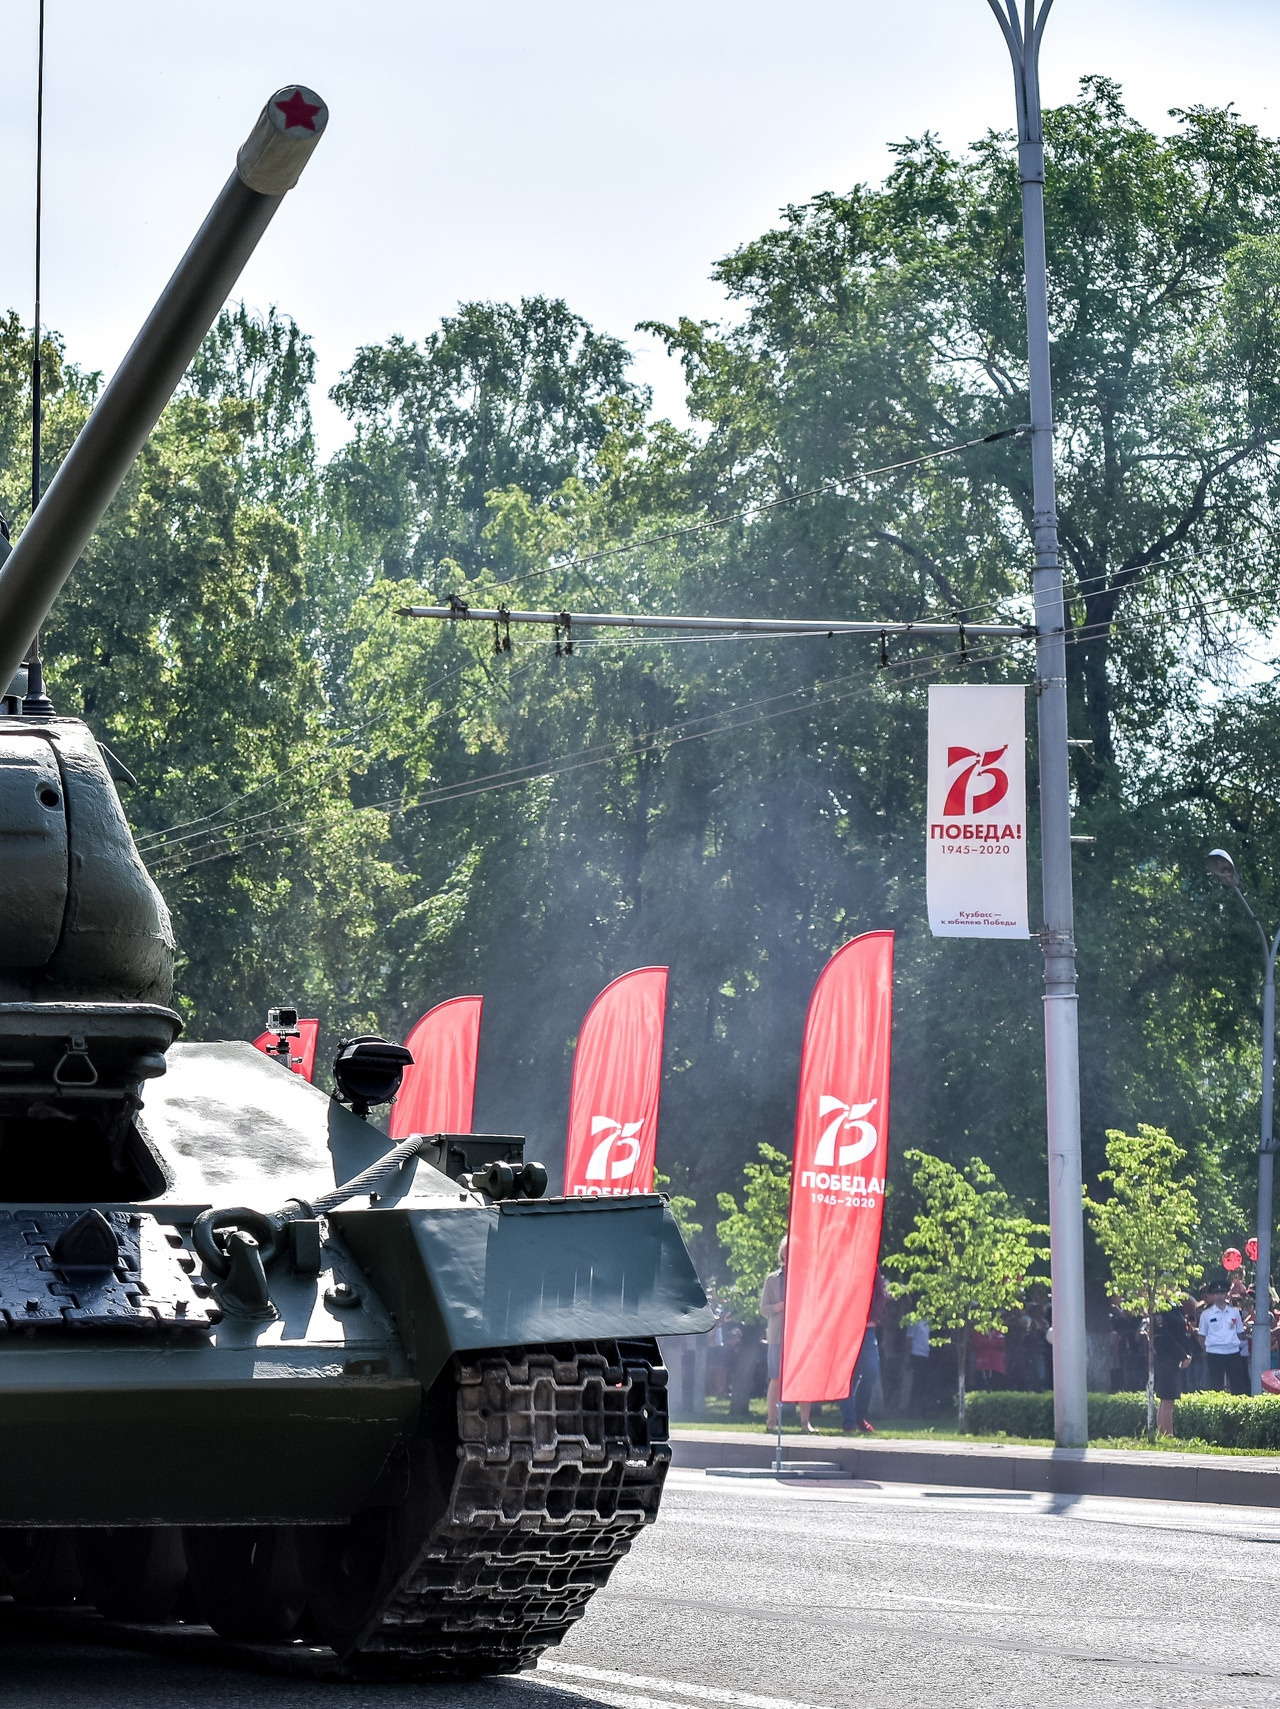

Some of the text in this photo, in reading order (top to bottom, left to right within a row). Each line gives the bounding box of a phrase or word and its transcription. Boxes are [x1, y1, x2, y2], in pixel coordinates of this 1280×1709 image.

[943, 744, 1009, 816] 75
[931, 824, 1022, 842] ПОБЕДА!
[959, 911, 992, 919] Кузбасс
[585, 1115, 645, 1180] 75
[813, 1095, 879, 1167] 75
[801, 1171, 886, 1196] ПОБЕДА!
